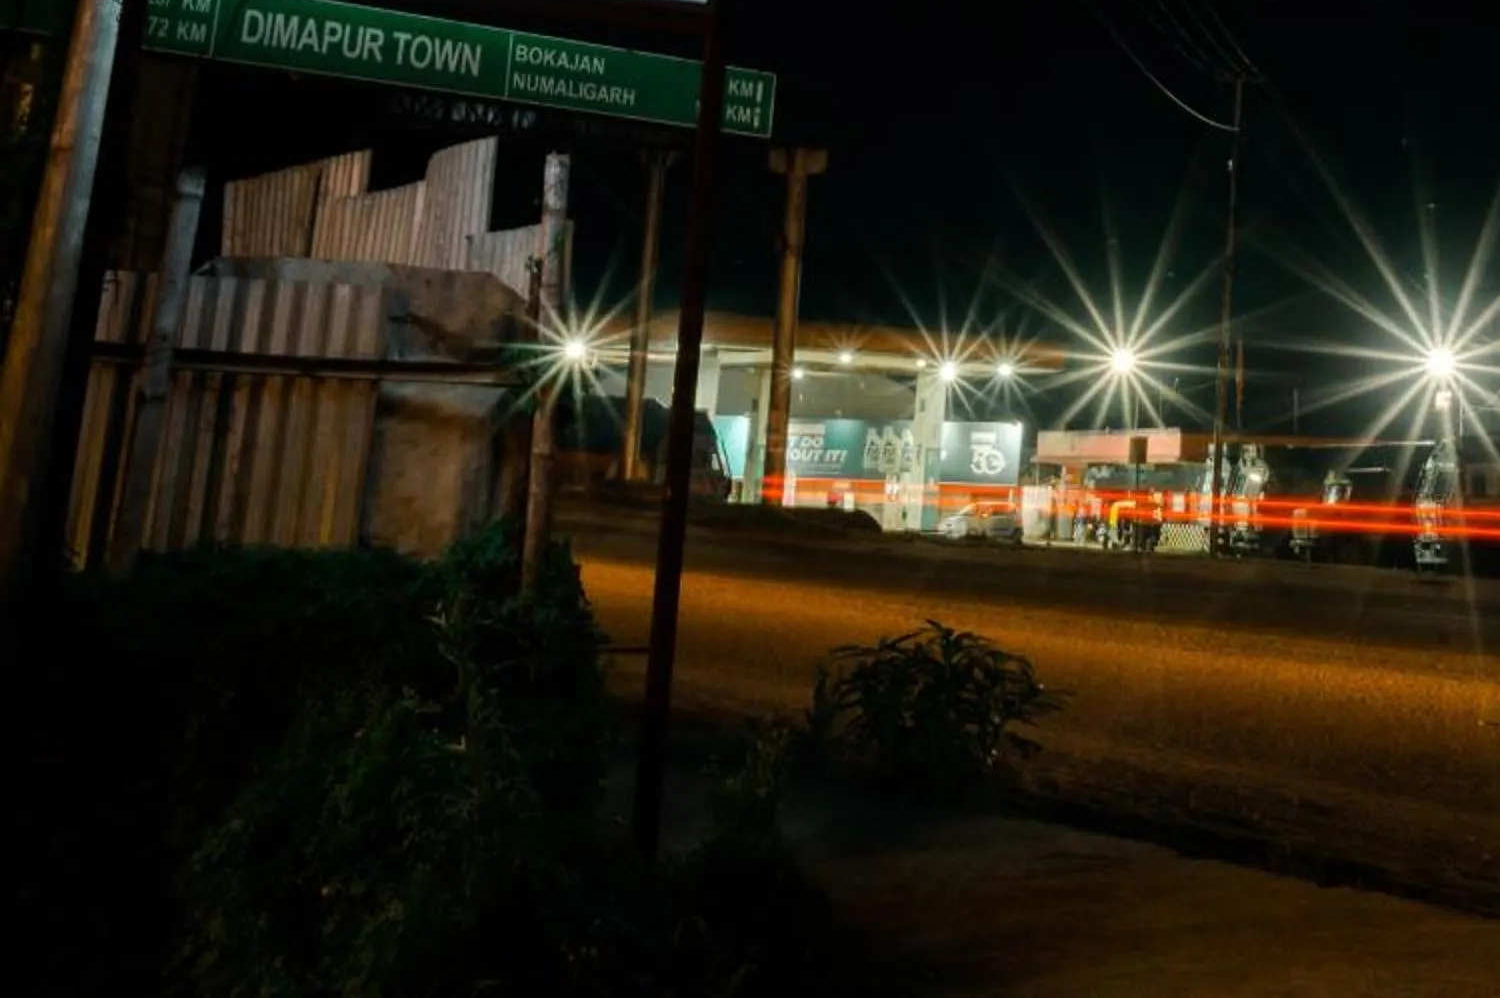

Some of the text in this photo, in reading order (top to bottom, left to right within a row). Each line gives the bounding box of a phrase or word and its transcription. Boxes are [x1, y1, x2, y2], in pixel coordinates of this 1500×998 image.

[176, 19, 208, 43] KM
[240, 9, 483, 77] DIMAPUR TOWN
[514, 44, 754, 98] BOKAJAN KM
[512, 73, 751, 124] NUMALIGARH KM
